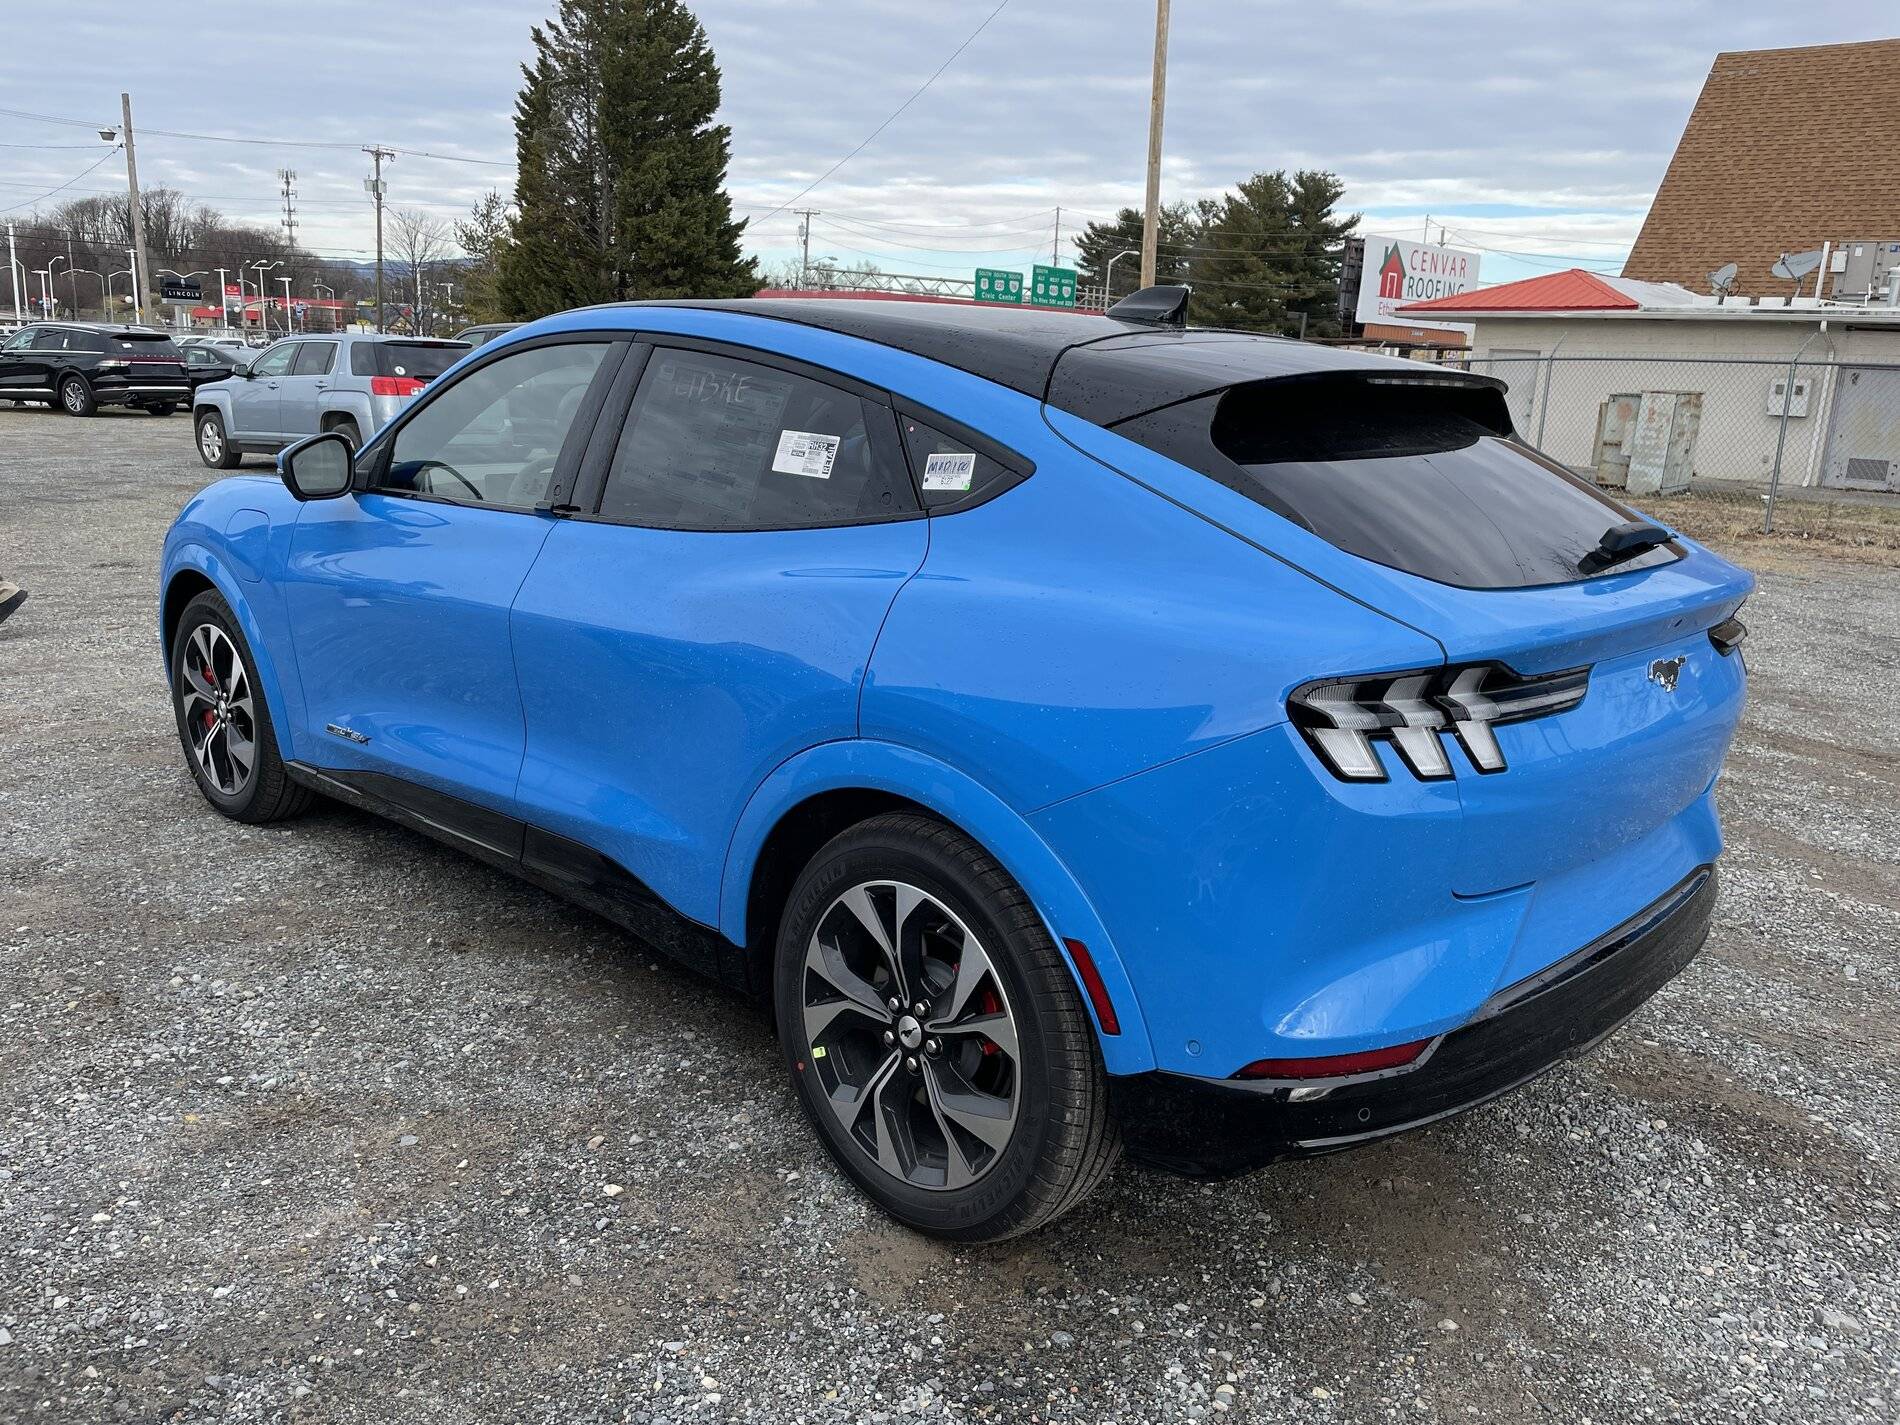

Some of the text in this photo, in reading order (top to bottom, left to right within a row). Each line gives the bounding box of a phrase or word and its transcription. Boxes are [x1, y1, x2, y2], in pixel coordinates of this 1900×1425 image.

[1410, 249, 1467, 278] CENVAR
[168, 290, 200, 298] LINCOLN
[981, 291, 1016, 301] Civic Center
[823, 443, 837, 473] RETAIL
